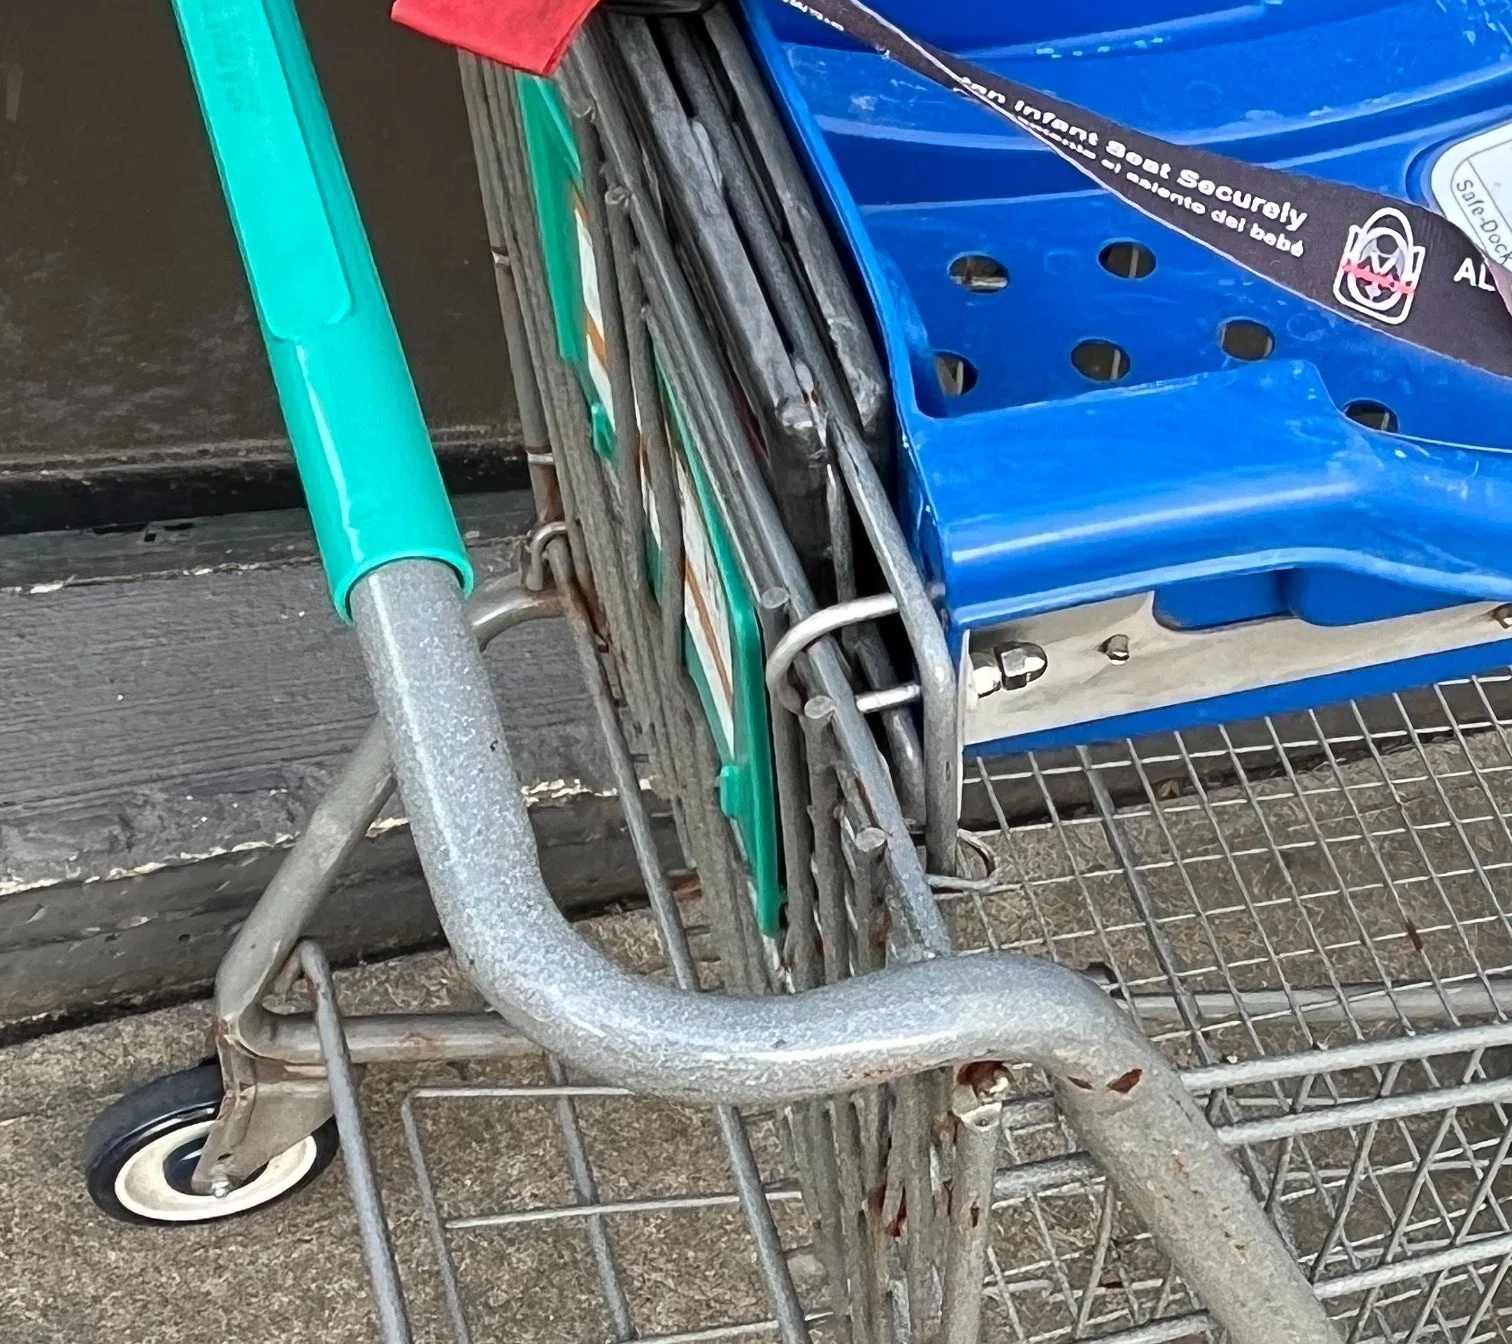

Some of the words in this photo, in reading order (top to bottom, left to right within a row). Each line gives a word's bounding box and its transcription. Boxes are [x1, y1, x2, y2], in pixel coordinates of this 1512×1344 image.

[1013, 98, 1099, 147] Infant
[1104, 139, 1172, 180] Seat
[1176, 168, 1308, 233] Securely
